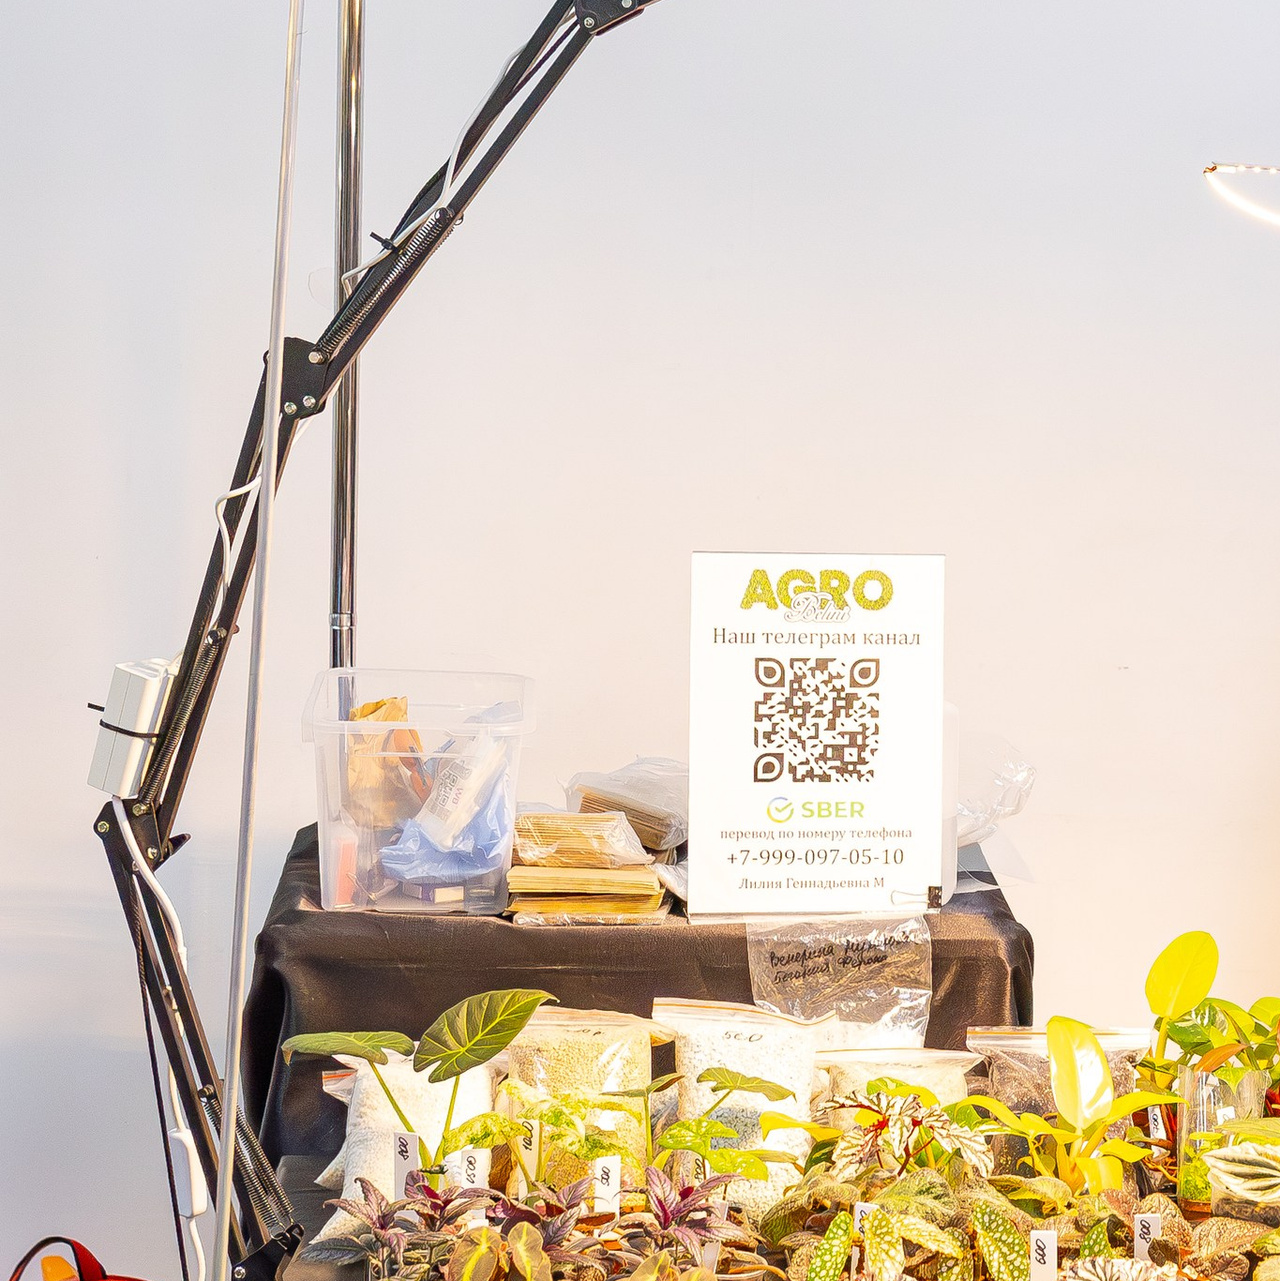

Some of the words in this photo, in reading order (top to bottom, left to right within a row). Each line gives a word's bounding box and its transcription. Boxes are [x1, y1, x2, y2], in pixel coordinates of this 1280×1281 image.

[740, 568, 894, 611] AGRO
[713, 627, 756, 645] Наш
[762, 632, 856, 649] телеграм
[863, 632, 921, 646] канал
[801, 801, 865, 819] SBER
[720, 829, 775, 841] перевод
[778, 829, 794, 839] по
[798, 829, 847, 842] номеру
[849, 827, 912, 841] телефона
[727, 848, 904, 866] +7-999-097-05-10
[738, 878, 782, 890] Лилия
[786, 878, 870, 890] Геннадьевна
[873, 877, 885, 888] М
[1139, 1219, 1151, 1244] 800
[1035, 1238, 1047, 1265] 600
